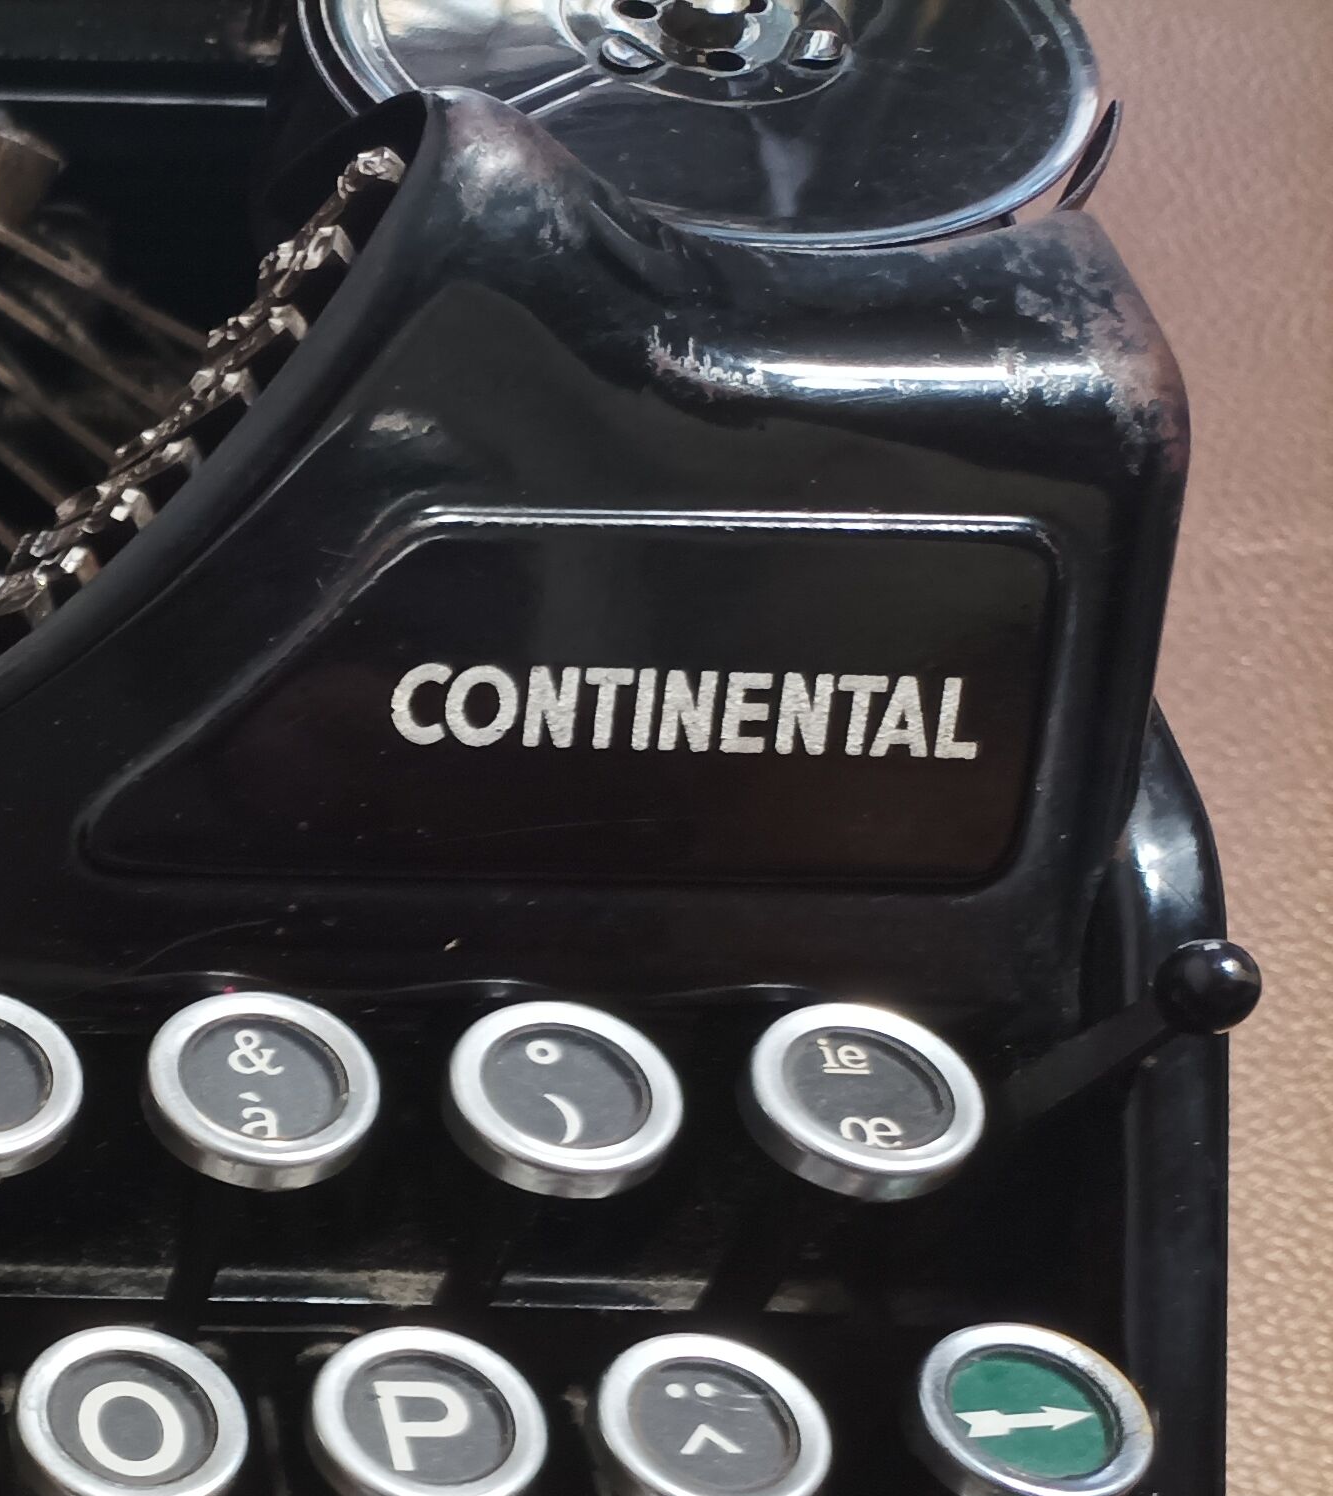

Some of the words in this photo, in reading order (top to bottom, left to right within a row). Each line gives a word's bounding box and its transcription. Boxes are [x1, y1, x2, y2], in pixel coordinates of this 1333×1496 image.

[390, 662, 979, 760] CONTINENTAL
[227, 1031, 284, 1075] &
[238, 1093, 278, 1138] à
[544, 1093, 580, 1143] )
[78, 1381, 184, 1476] O
[377, 1382, 469, 1471] P
